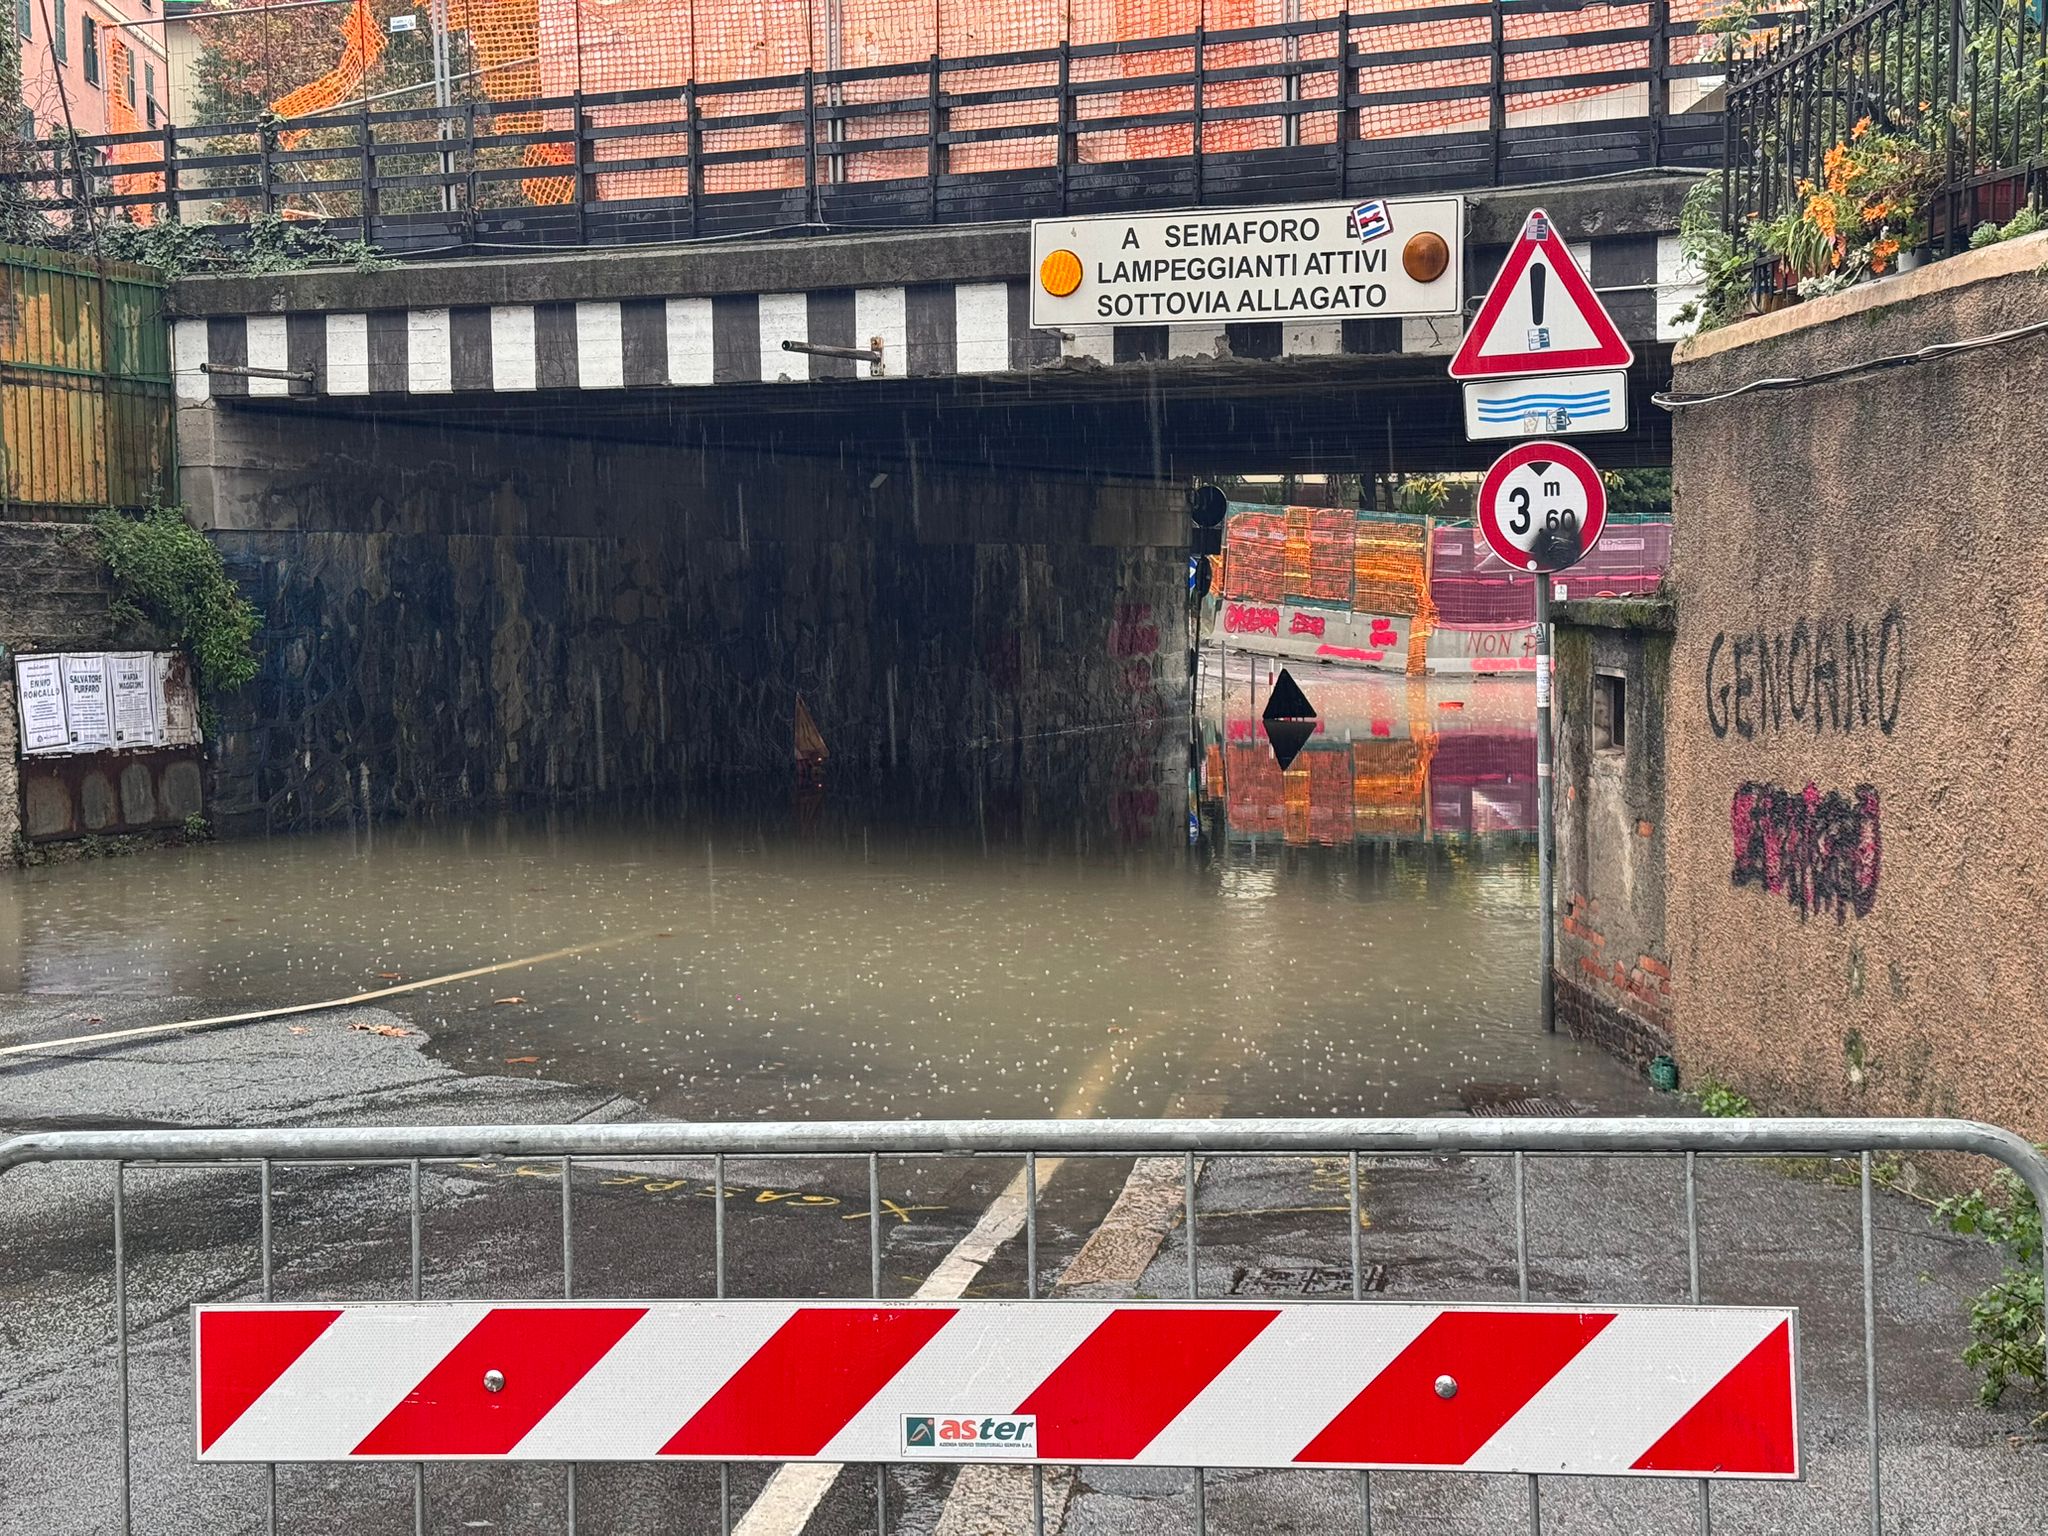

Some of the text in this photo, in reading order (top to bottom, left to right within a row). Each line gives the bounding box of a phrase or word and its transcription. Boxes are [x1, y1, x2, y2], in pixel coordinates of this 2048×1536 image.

[1121, 227, 1140, 250] A
[1164, 217, 1320, 248] SEMAFORO
[1097, 249, 1387, 284] LAMPEGGIANTI ATTIVI
[1097, 284, 1387, 317] SOTTOVIA ALLAGATO
[1544, 481, 1560, 497] m
[1508, 486, 1531, 535] 3
[1467, 631, 1513, 655] NON
[69, 674, 102, 684] SALVATORE
[938, 1417, 1034, 1441] aster
